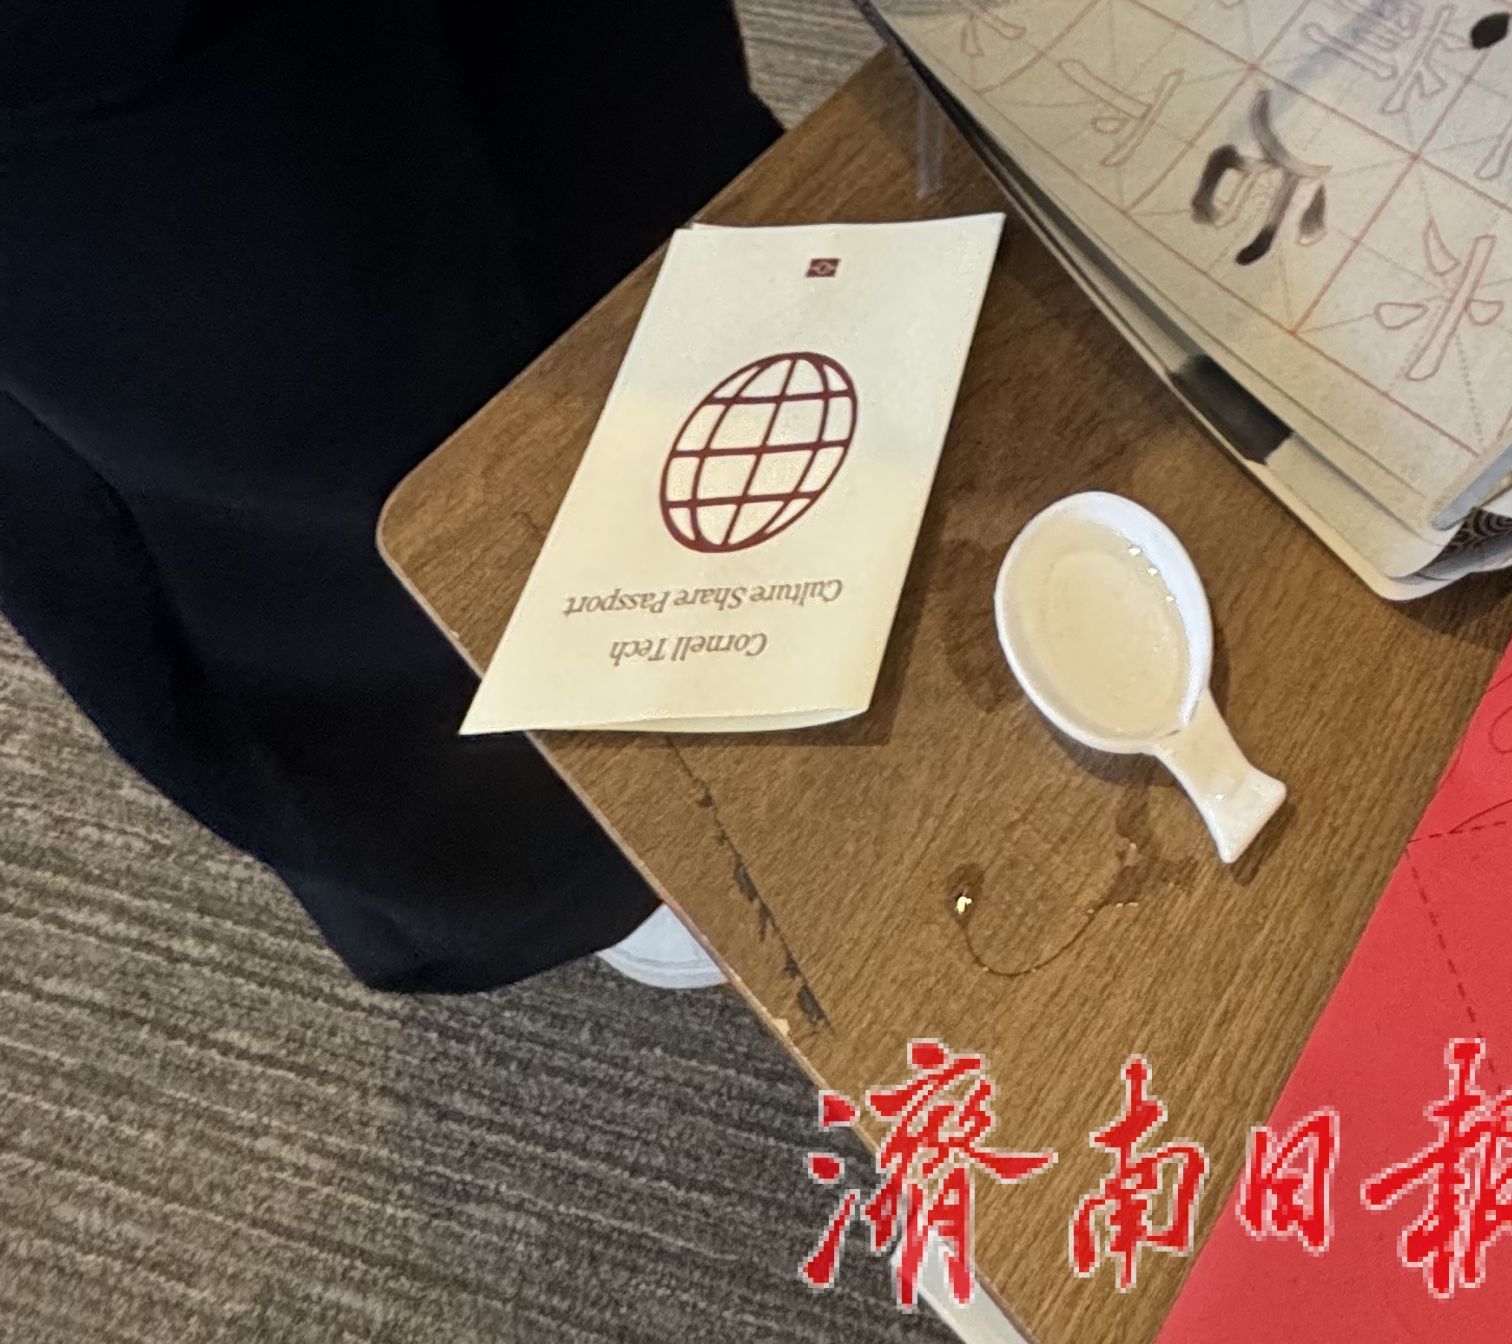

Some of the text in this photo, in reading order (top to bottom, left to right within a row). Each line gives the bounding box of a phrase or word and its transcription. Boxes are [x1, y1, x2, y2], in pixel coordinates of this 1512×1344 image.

[563, 579, 843, 616] Culture Share Passport
[608, 632, 768, 666] Cornell Tech
